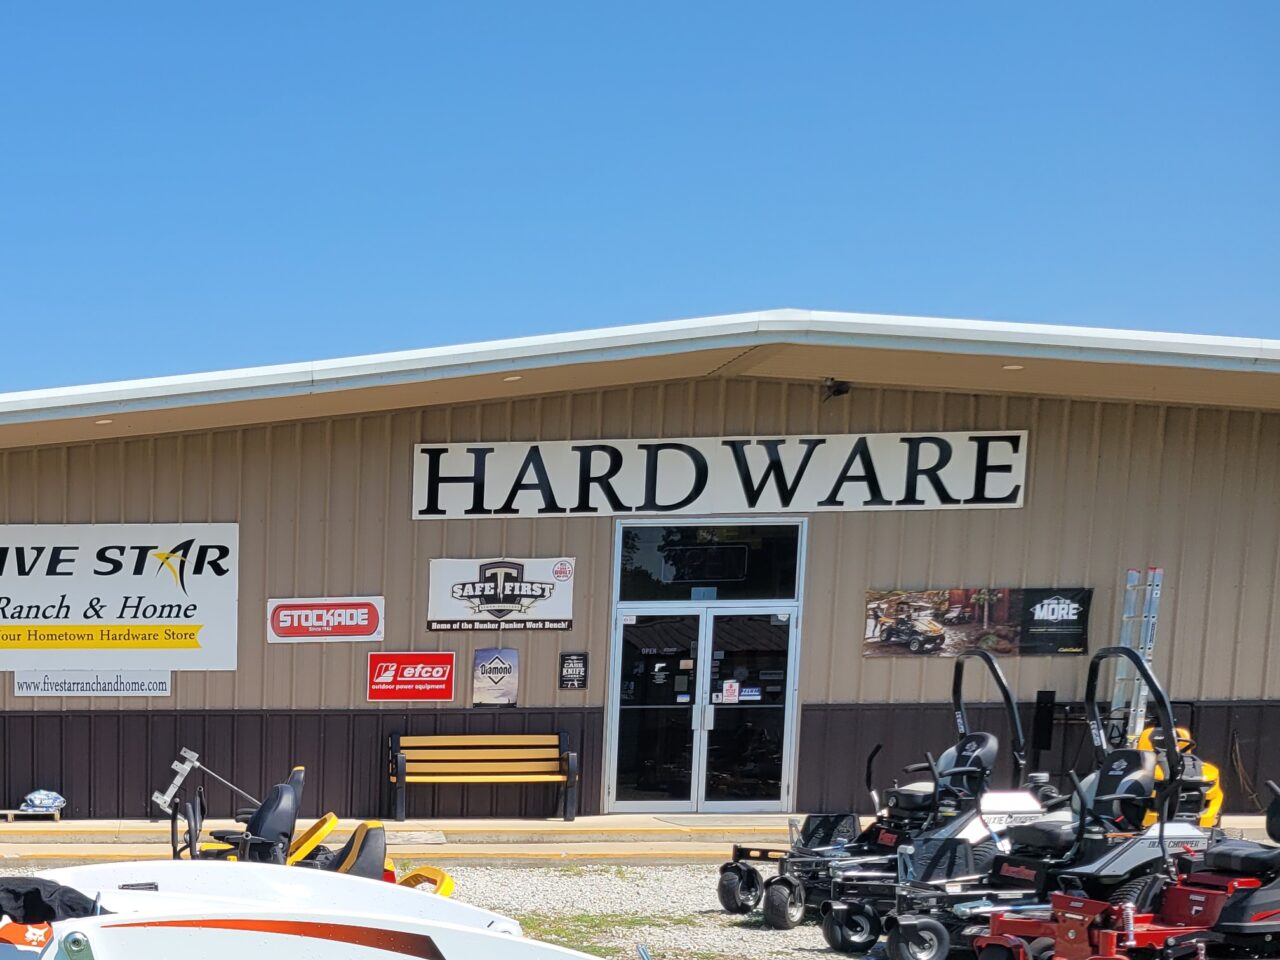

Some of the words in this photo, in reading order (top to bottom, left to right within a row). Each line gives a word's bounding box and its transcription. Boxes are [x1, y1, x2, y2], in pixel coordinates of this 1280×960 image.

[418, 435, 1022, 515] HARDWARE
[93, 538, 230, 598] STAR
[452, 582, 495, 597] SAFE
[504, 582, 554, 597] FIRST
[82, 596, 107, 619] &
[116, 595, 197, 619] Home
[1033, 603, 1079, 620] MORE
[279, 608, 369, 628] STOCKADE
[27, 630, 94, 642] Hometown
[100, 629, 159, 642] Hardware
[164, 629, 195, 641] Store
[403, 664, 444, 678] efco
[480, 664, 512, 674] Diamond
[562, 667, 585, 676] KNIFE
[17, 675, 168, 693] www.fivestarranchandhome.com
